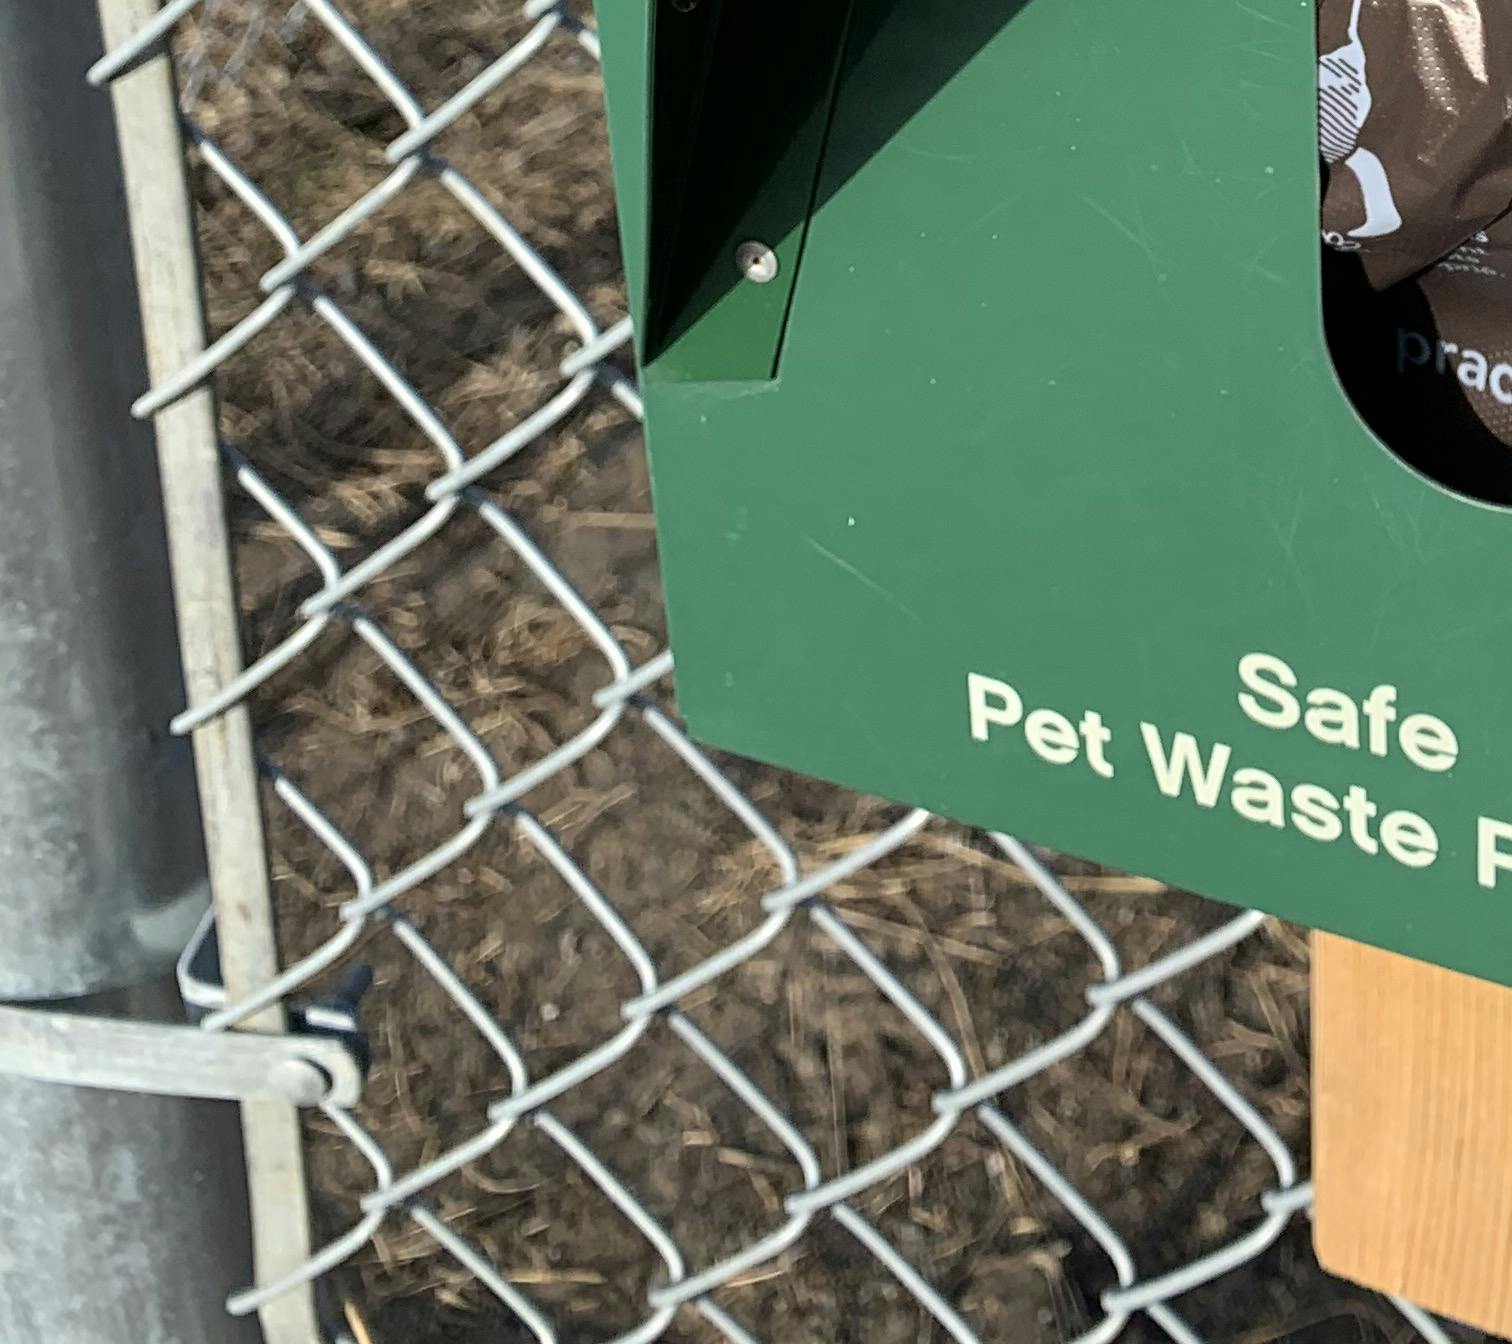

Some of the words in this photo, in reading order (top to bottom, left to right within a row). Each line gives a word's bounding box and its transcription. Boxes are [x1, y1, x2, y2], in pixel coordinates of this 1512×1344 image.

[968, 673, 1113, 777] Pet
[1141, 722, 1438, 867] Waste
[1239, 654, 1458, 771] Safe
